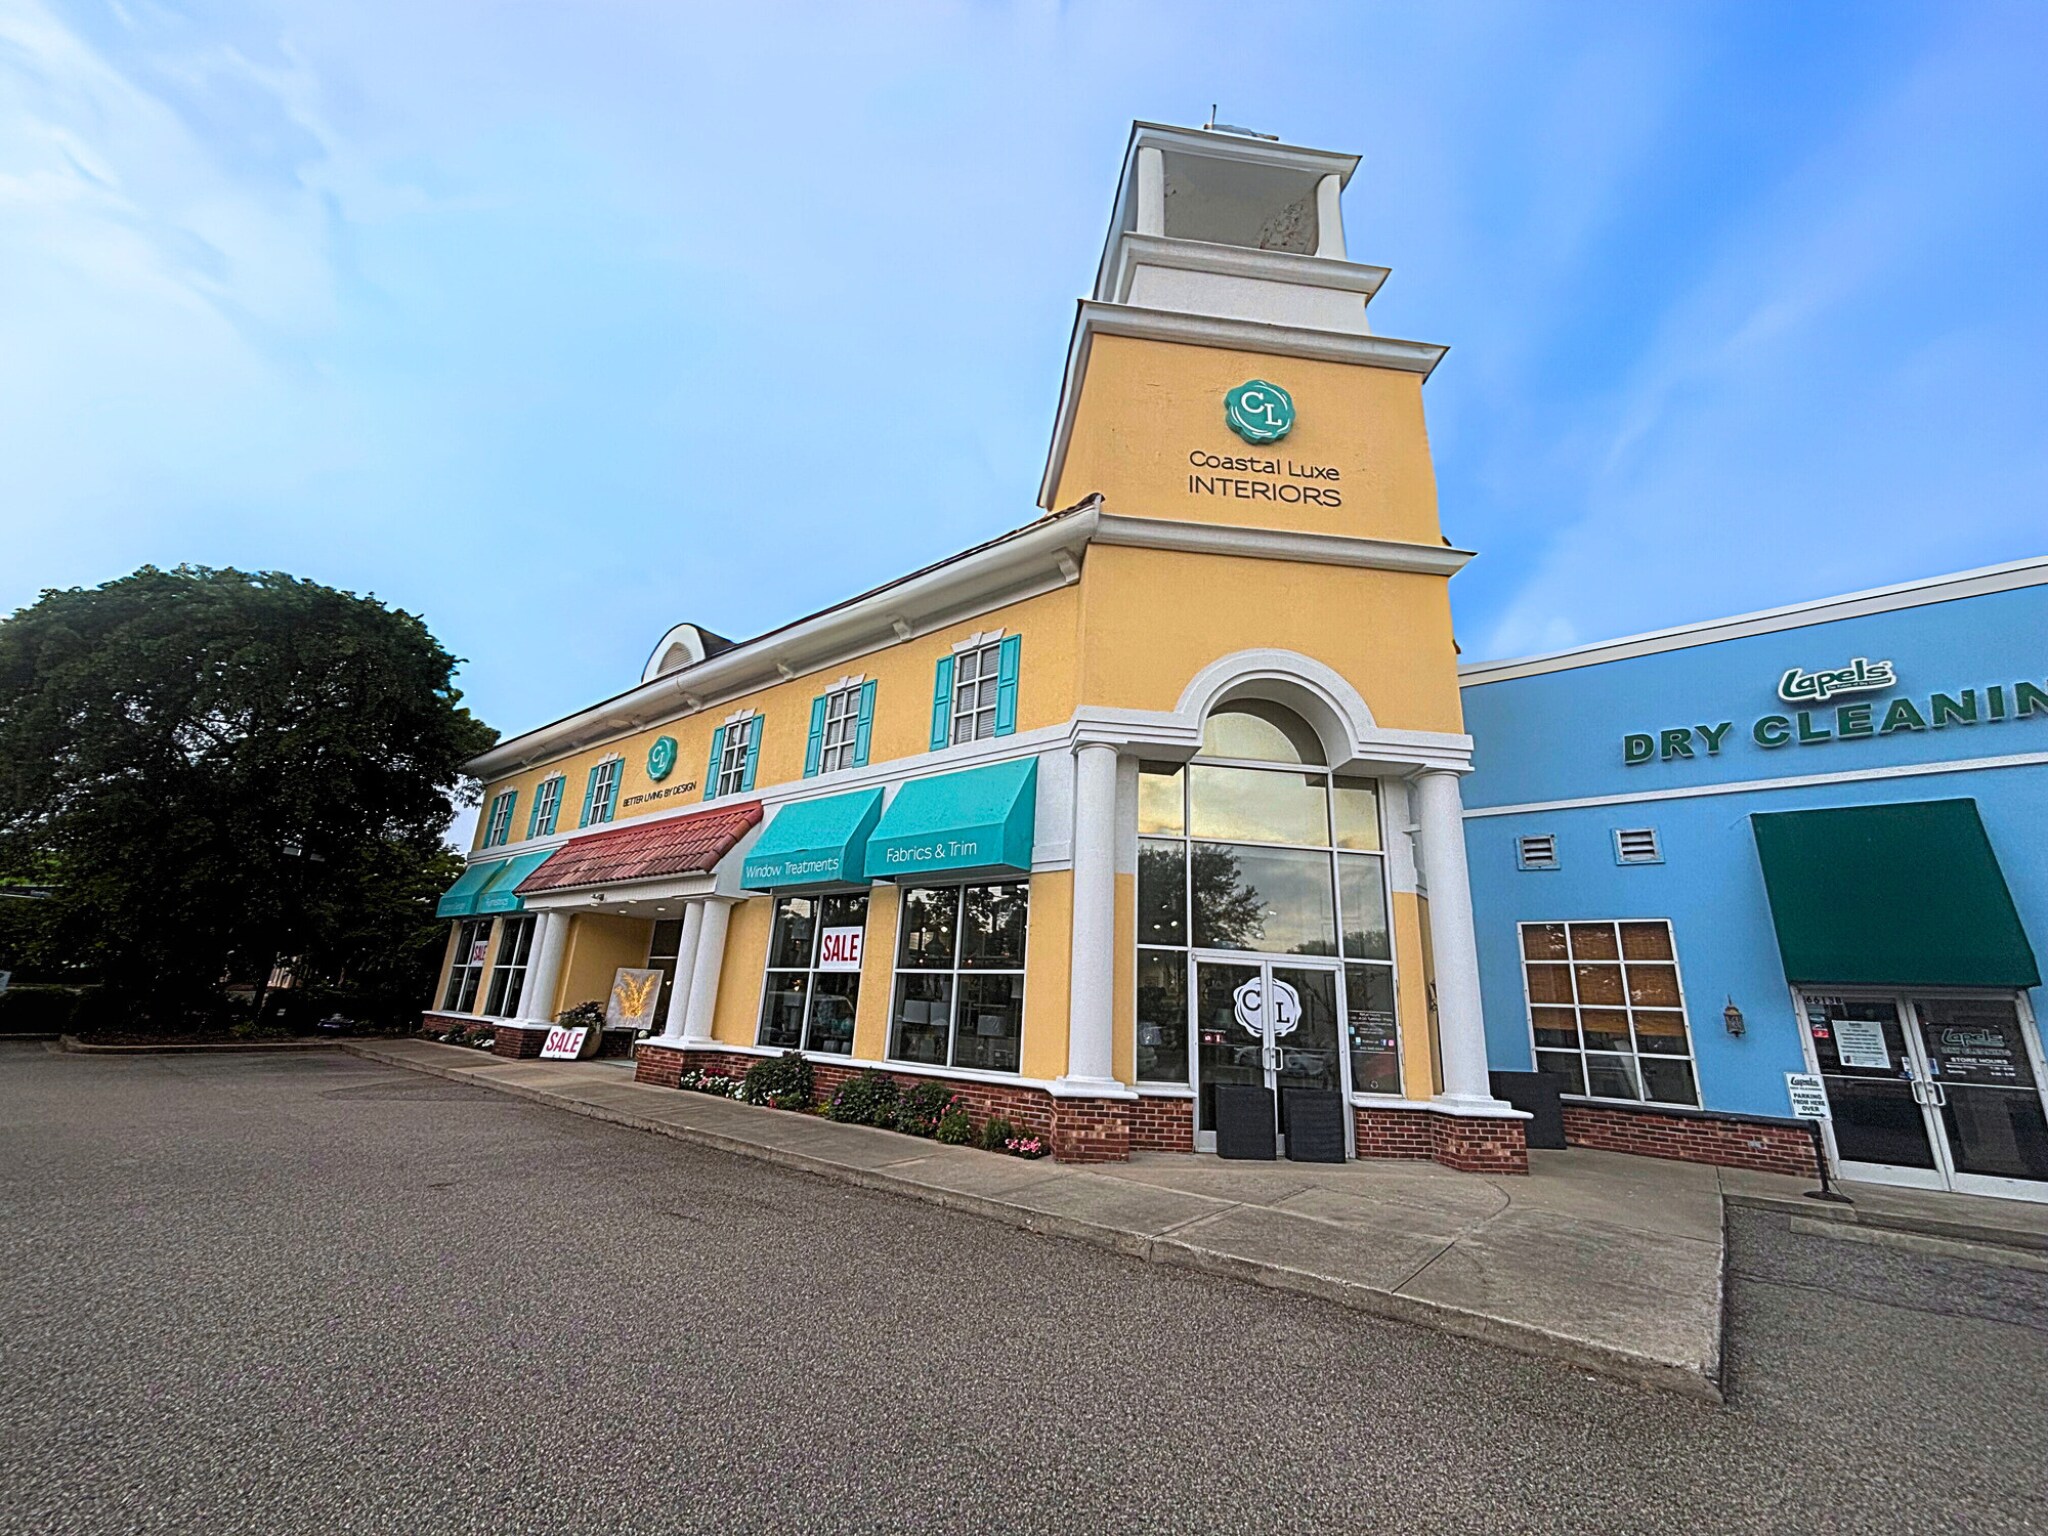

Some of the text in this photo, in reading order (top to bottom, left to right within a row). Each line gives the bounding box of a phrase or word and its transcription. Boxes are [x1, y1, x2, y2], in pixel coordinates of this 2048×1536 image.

[1189, 450, 1341, 481] Coastal Luxe
[1189, 474, 1342, 508] INTERIORS
[1781, 659, 1889, 698] Lapels
[1623, 680, 2048, 766] DRY CLEANIN
[623, 780, 697, 807] BETTER LIVING BY DESIGN
[886, 841, 977, 863] Fabrics & Trim
[746, 857, 839, 879] Window Treatments
[823, 934, 860, 962] SALE
[545, 1031, 584, 1053] SALE
[1950, 1056, 1978, 1064] STORE
